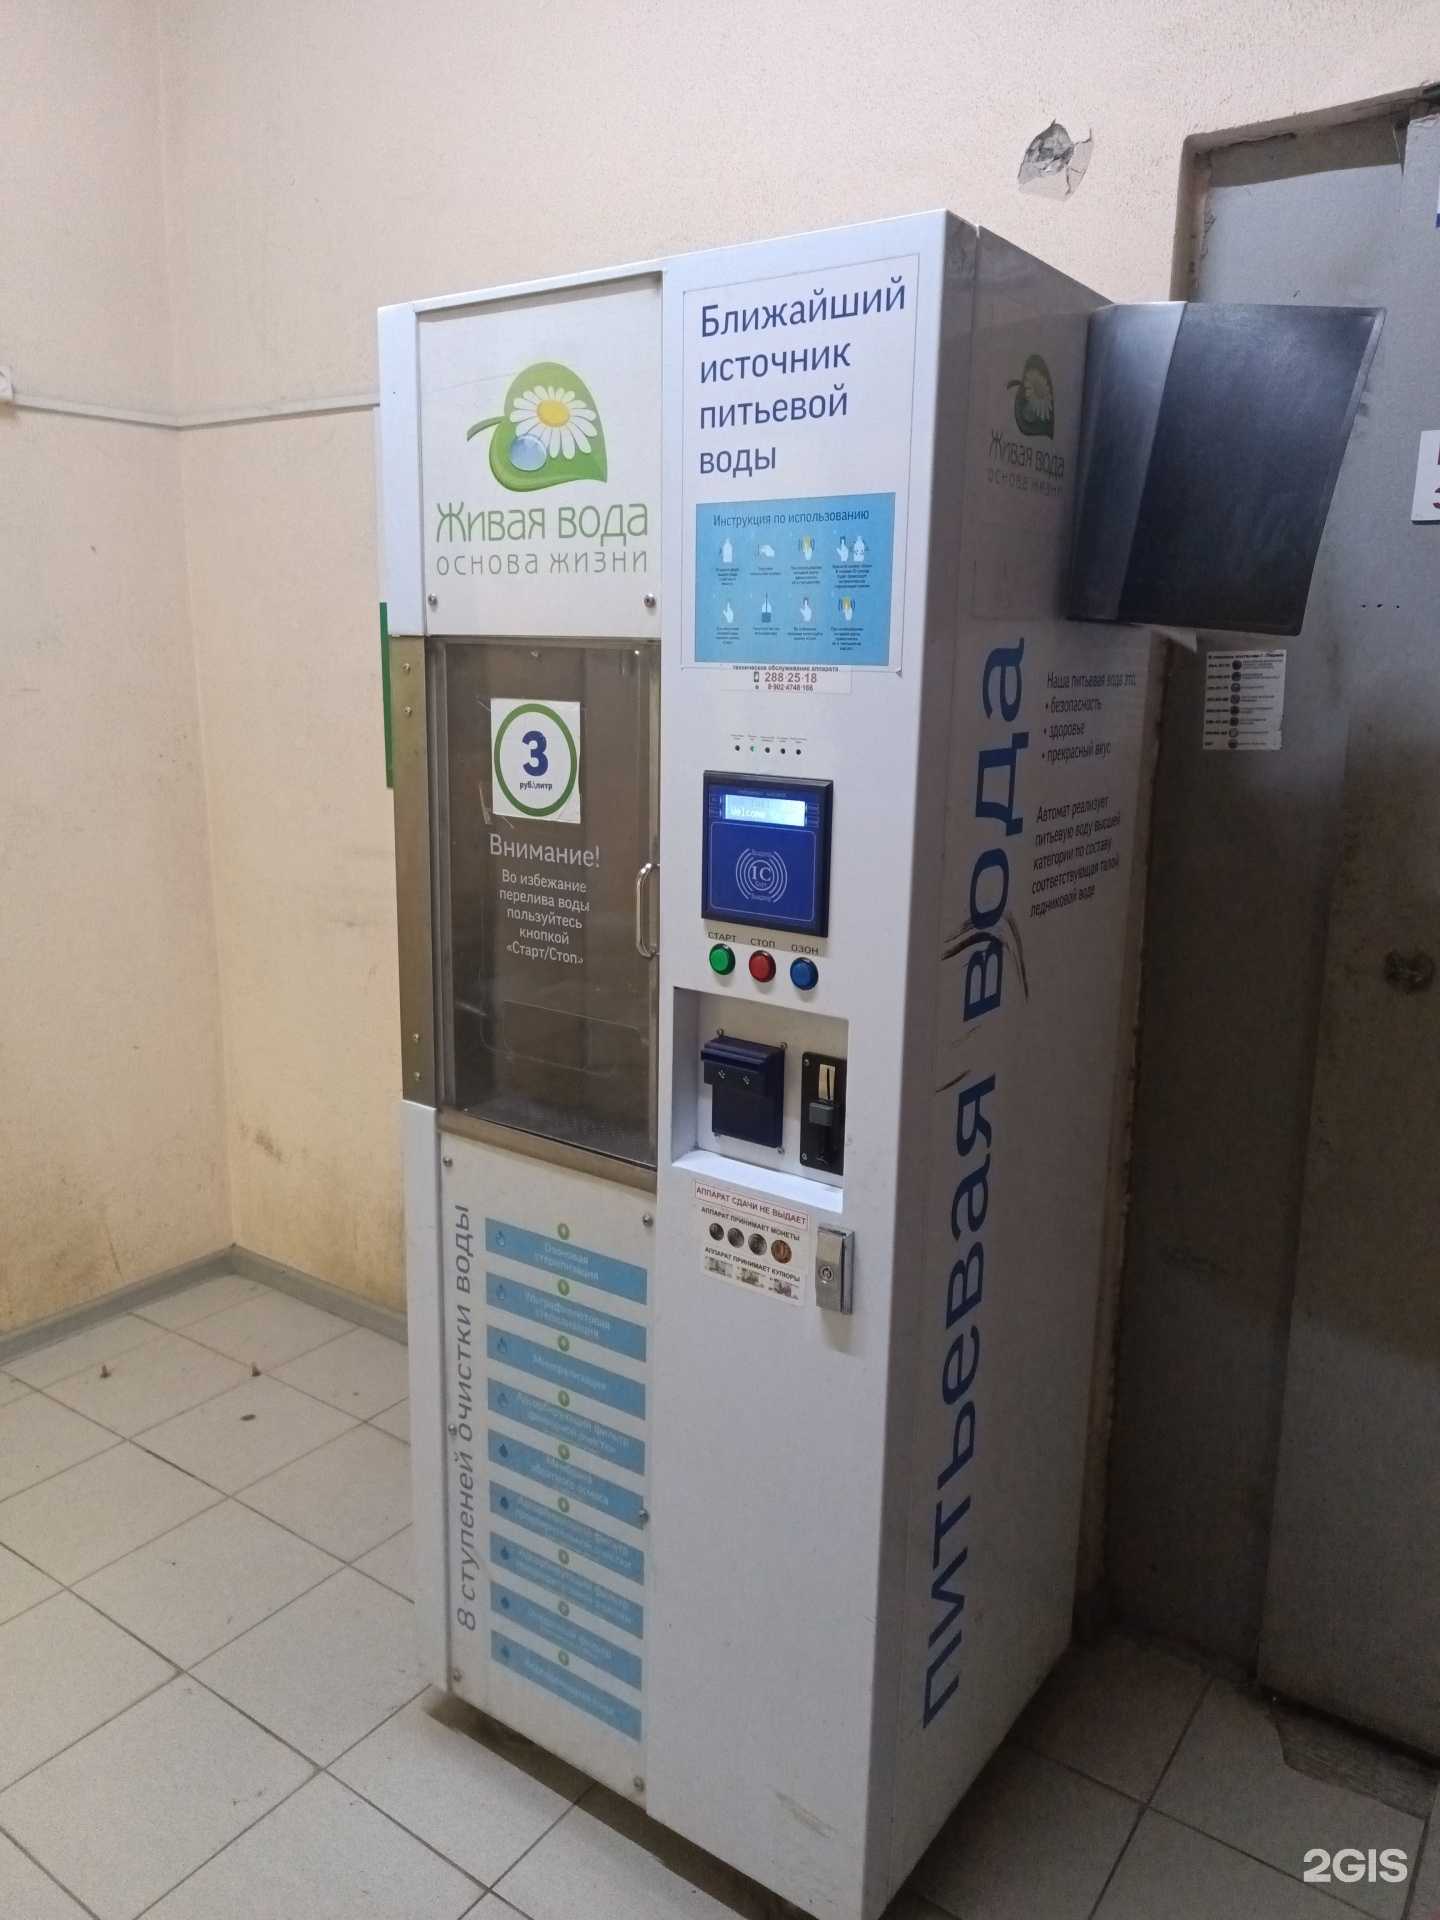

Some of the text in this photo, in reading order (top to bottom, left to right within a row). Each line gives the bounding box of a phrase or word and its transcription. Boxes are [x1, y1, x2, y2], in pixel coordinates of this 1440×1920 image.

[701, 275, 906, 338] Ближайший
[700, 342, 852, 384] источник
[700, 382, 849, 430] питьевой
[699, 446, 777, 479] воды
[435, 501, 649, 547] Живая вода
[713, 509, 870, 529] Инструкция по использованию
[435, 550, 648, 576] основа жизни
[522, 730, 549, 777] 3
[962, 637, 1029, 1023] вода
[489, 833, 600, 868] Внимание!
[502, 868, 587, 894] Во избежание
[499, 889, 590, 914] перелива воды
[507, 908, 583, 930] пользуйтесь
[519, 927, 570, 945] кнопкой
[707, 931, 737, 943] СТАРТ
[750, 938, 776, 949] СТОП
[791, 944, 819, 955] ОЗОН
[696, 1186, 807, 1226] АППАРАТ СДАЧИ НЕ ВЫДАЕТ
[701, 1206, 730, 1220] АППАРАТ
[705, 1247, 732, 1262] АППАРАТ
[454, 1204, 480, 1632] 8 ступеней очистки воды
